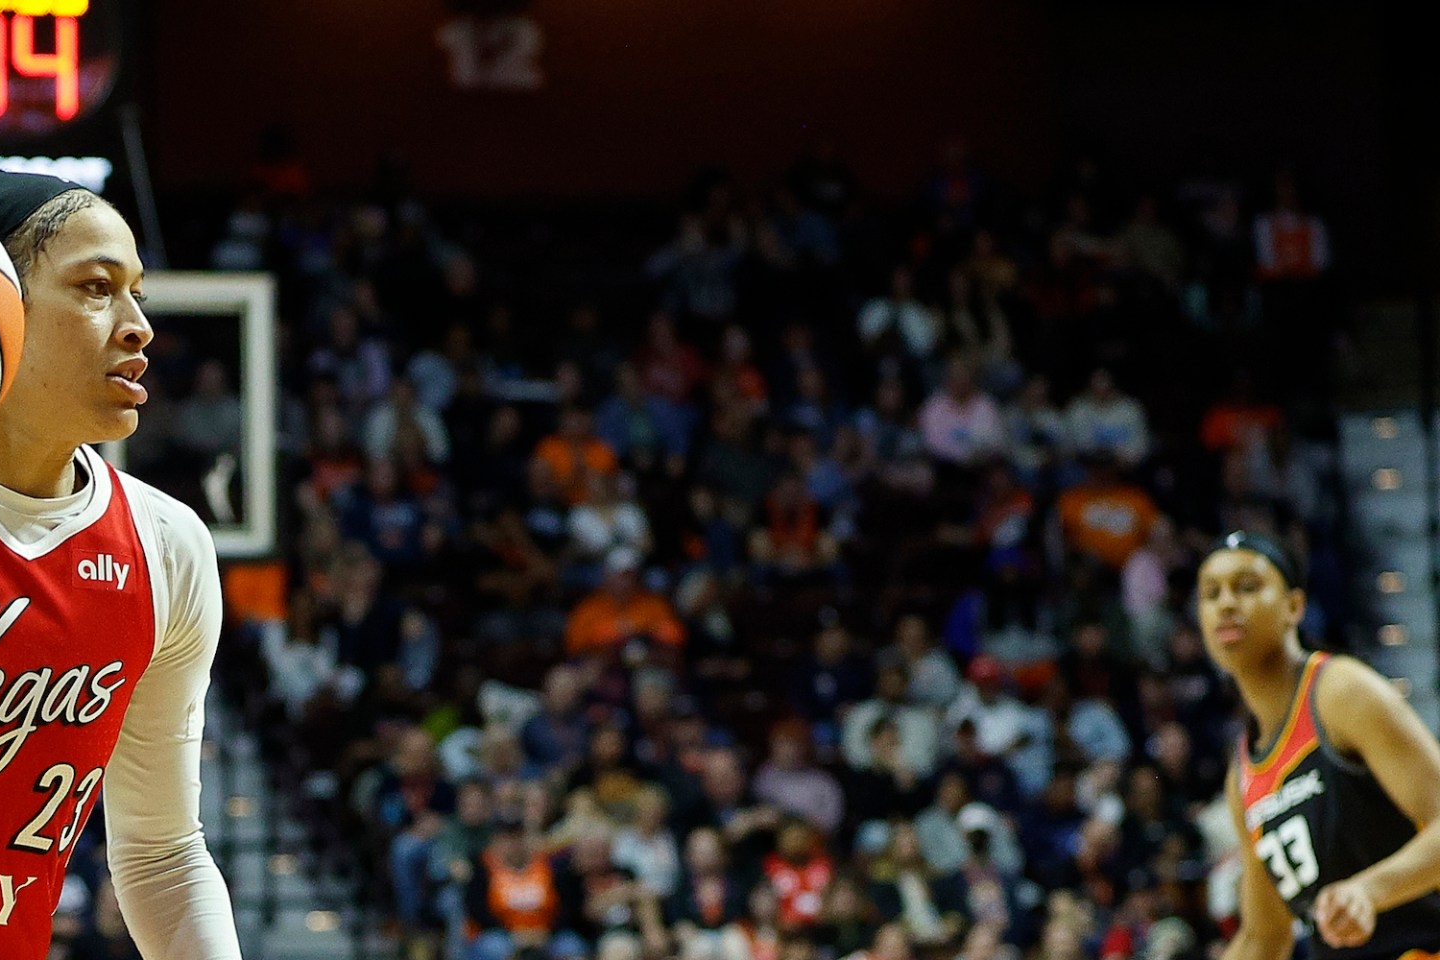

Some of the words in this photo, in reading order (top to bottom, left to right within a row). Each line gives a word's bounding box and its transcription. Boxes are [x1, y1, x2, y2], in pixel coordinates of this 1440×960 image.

[436, 18, 546, 88] 12
[77, 553, 130, 591] ally
[8, 762, 103, 851] 23
[1255, 814, 1319, 900] 33
